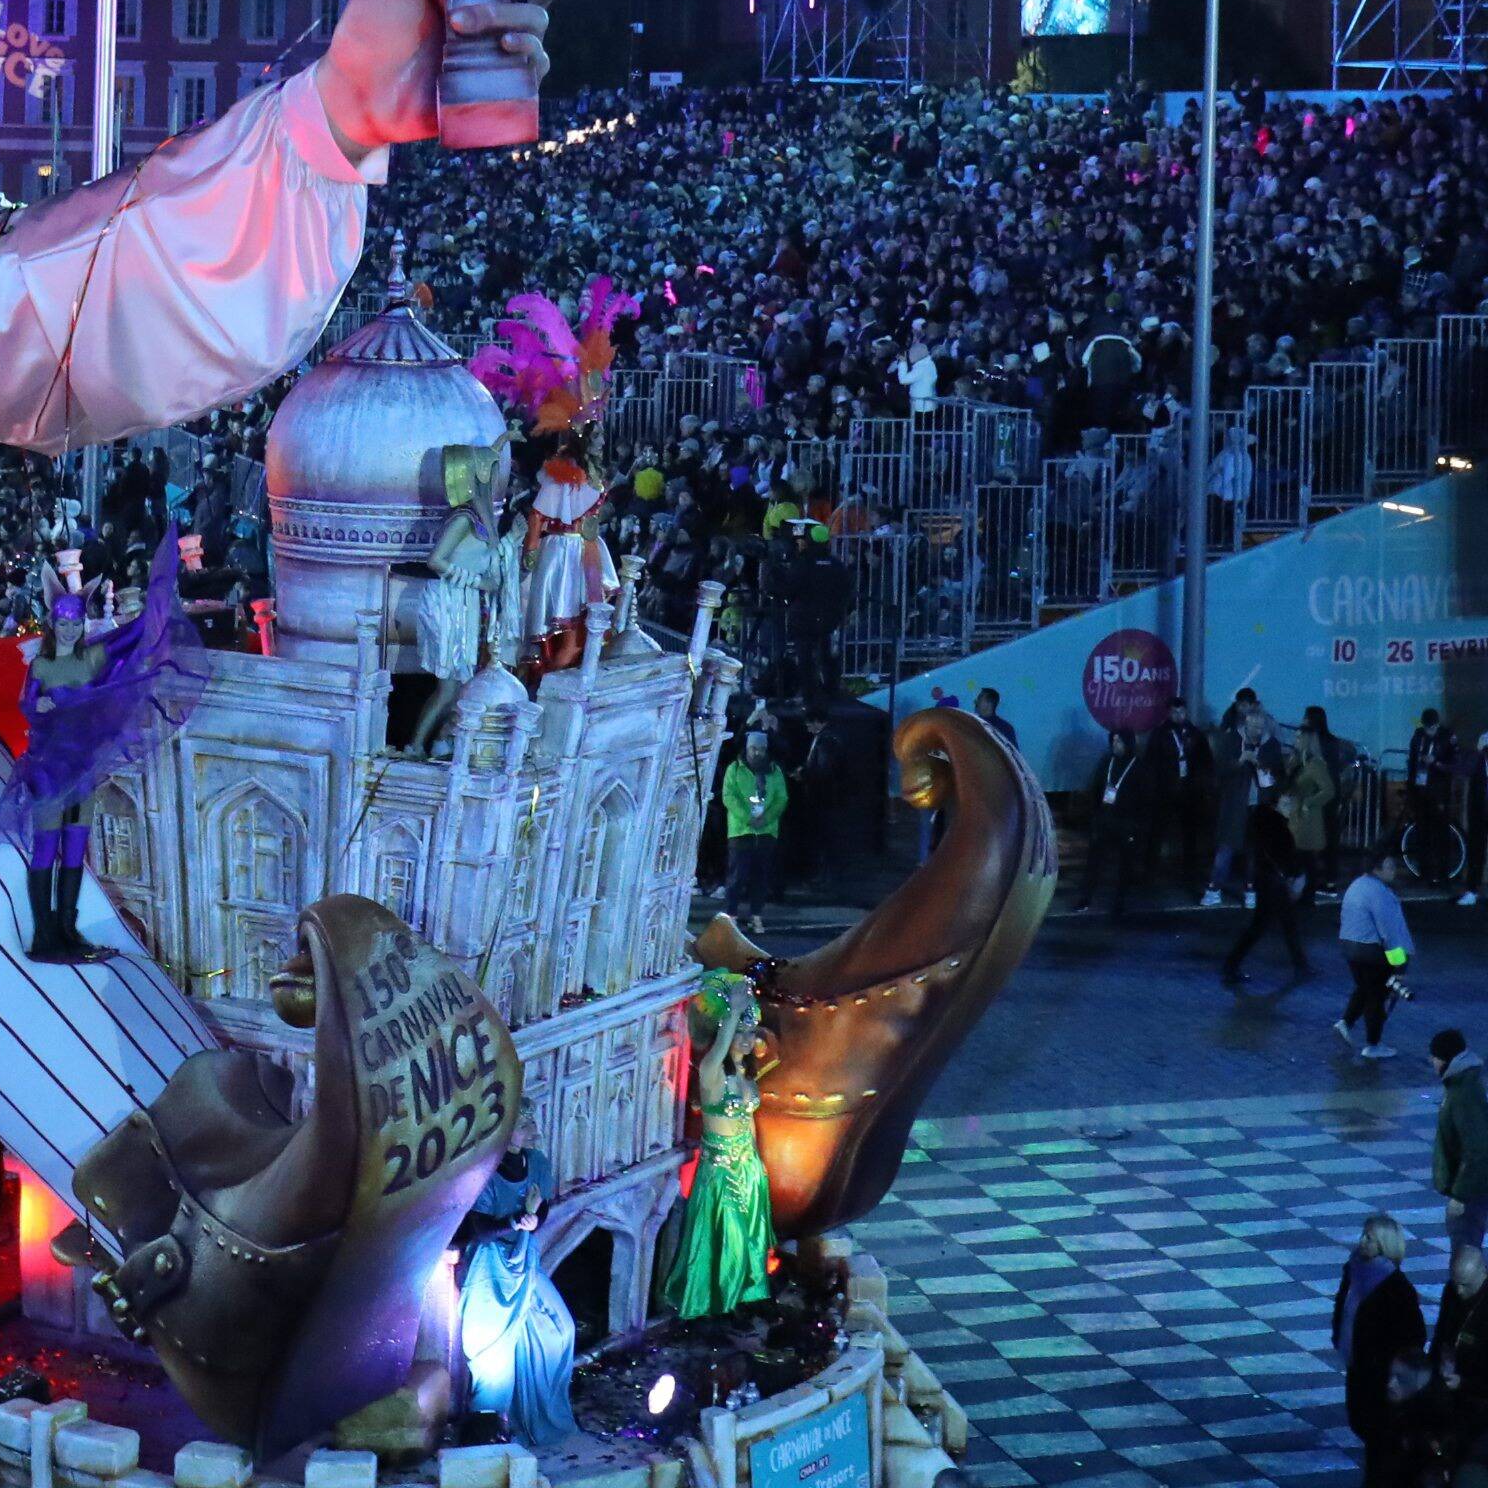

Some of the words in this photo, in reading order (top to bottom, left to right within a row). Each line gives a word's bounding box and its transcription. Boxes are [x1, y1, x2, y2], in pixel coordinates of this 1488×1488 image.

[1093, 655, 1139, 683] 150
[1141, 667, 1170, 682] ANS
[1333, 639, 1357, 662] 10
[1386, 639, 1414, 663] 26
[359, 972, 474, 1071] CARNAVAL
[368, 1074, 409, 1133] DE
[409, 1012, 497, 1127] NICE
[382, 1080, 505, 1196] 2023
